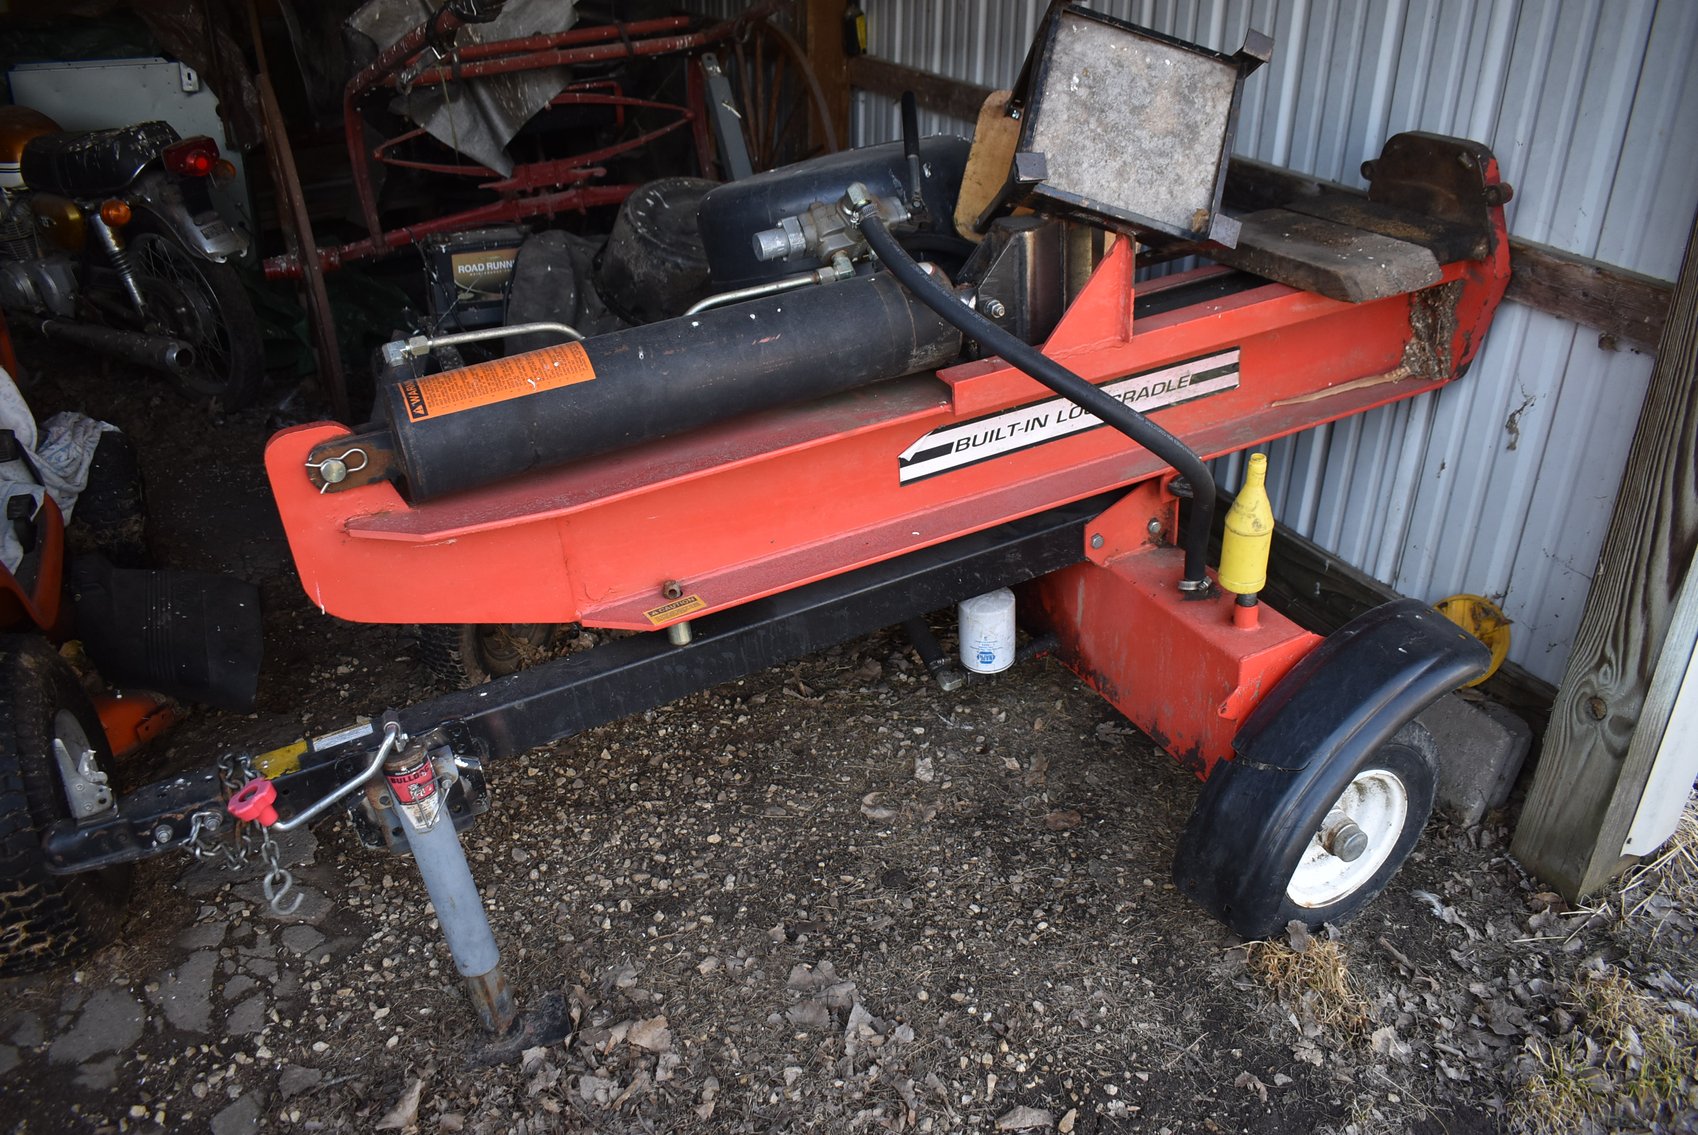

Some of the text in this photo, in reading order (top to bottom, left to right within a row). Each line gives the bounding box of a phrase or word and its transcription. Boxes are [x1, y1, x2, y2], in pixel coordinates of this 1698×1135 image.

[458, 263, 485, 274] ROAD
[486, 260, 515, 271] RUNN
[954, 413, 1050, 453] BUILT-IN
[1056, 405, 1091, 424] LO
[658, 596, 695, 613] CAUTION
[390, 765, 430, 784] BULLDOG
